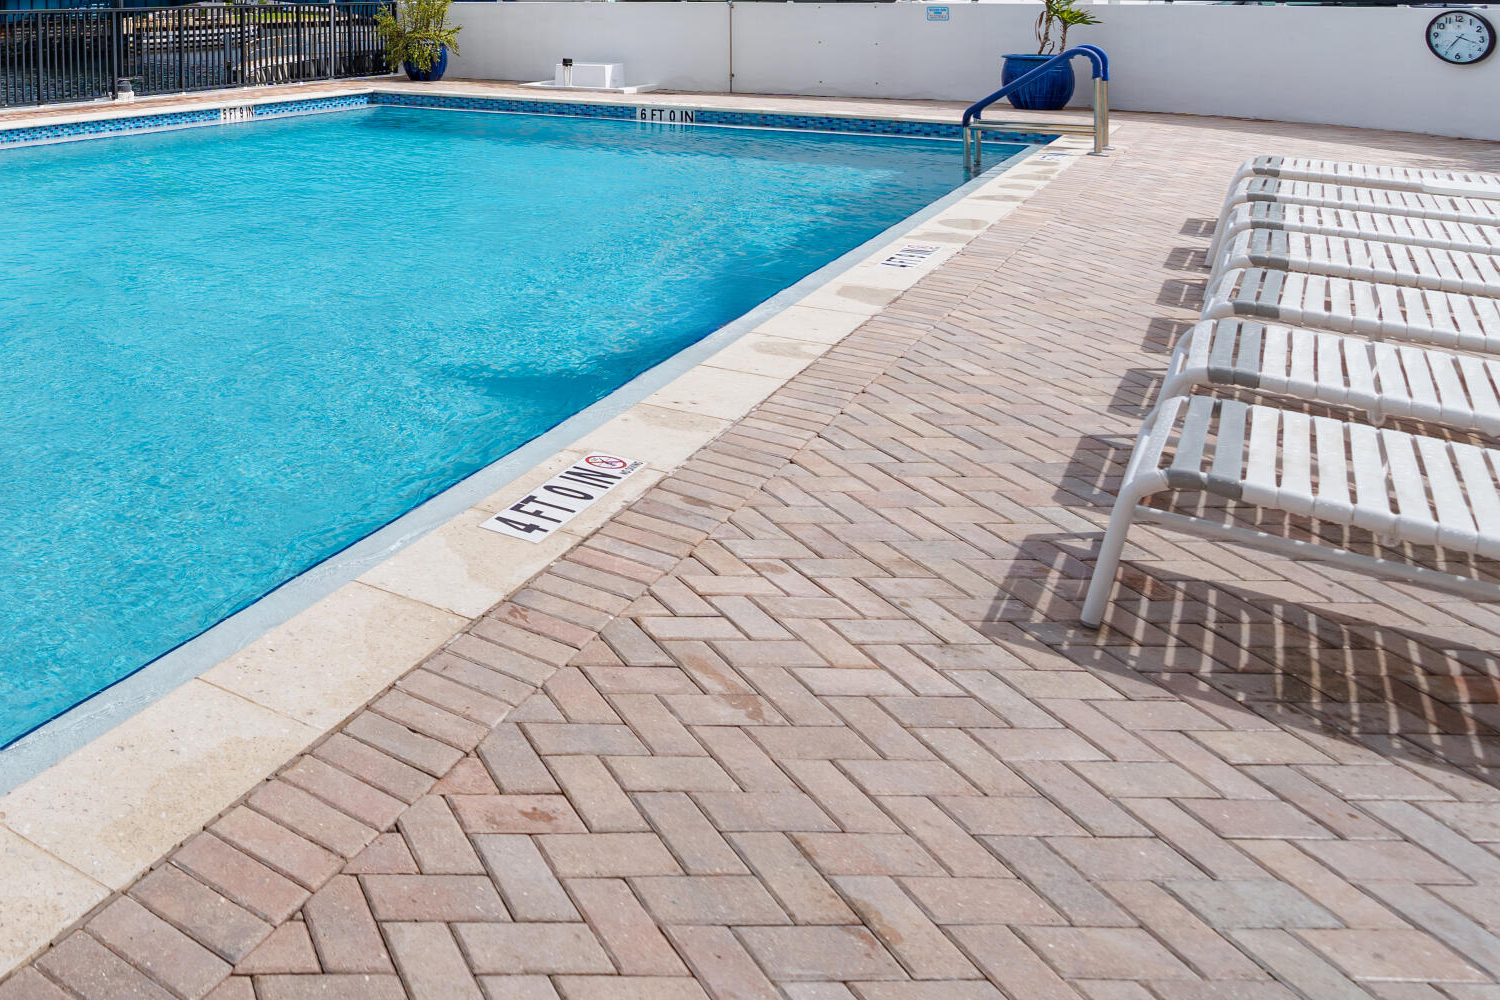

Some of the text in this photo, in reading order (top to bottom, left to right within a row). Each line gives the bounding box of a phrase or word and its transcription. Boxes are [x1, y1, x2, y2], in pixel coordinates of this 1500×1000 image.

[1479, 35, 1485, 43] 3
[229, 107, 237, 119] FT
[246, 105, 254, 118] IN
[640, 108, 646, 120] 6
[651, 109, 664, 121] FT
[680, 110, 694, 123] IN
[558, 465, 622, 489] IN
[509, 495, 576, 523] FT
[494, 516, 549, 534] 4
